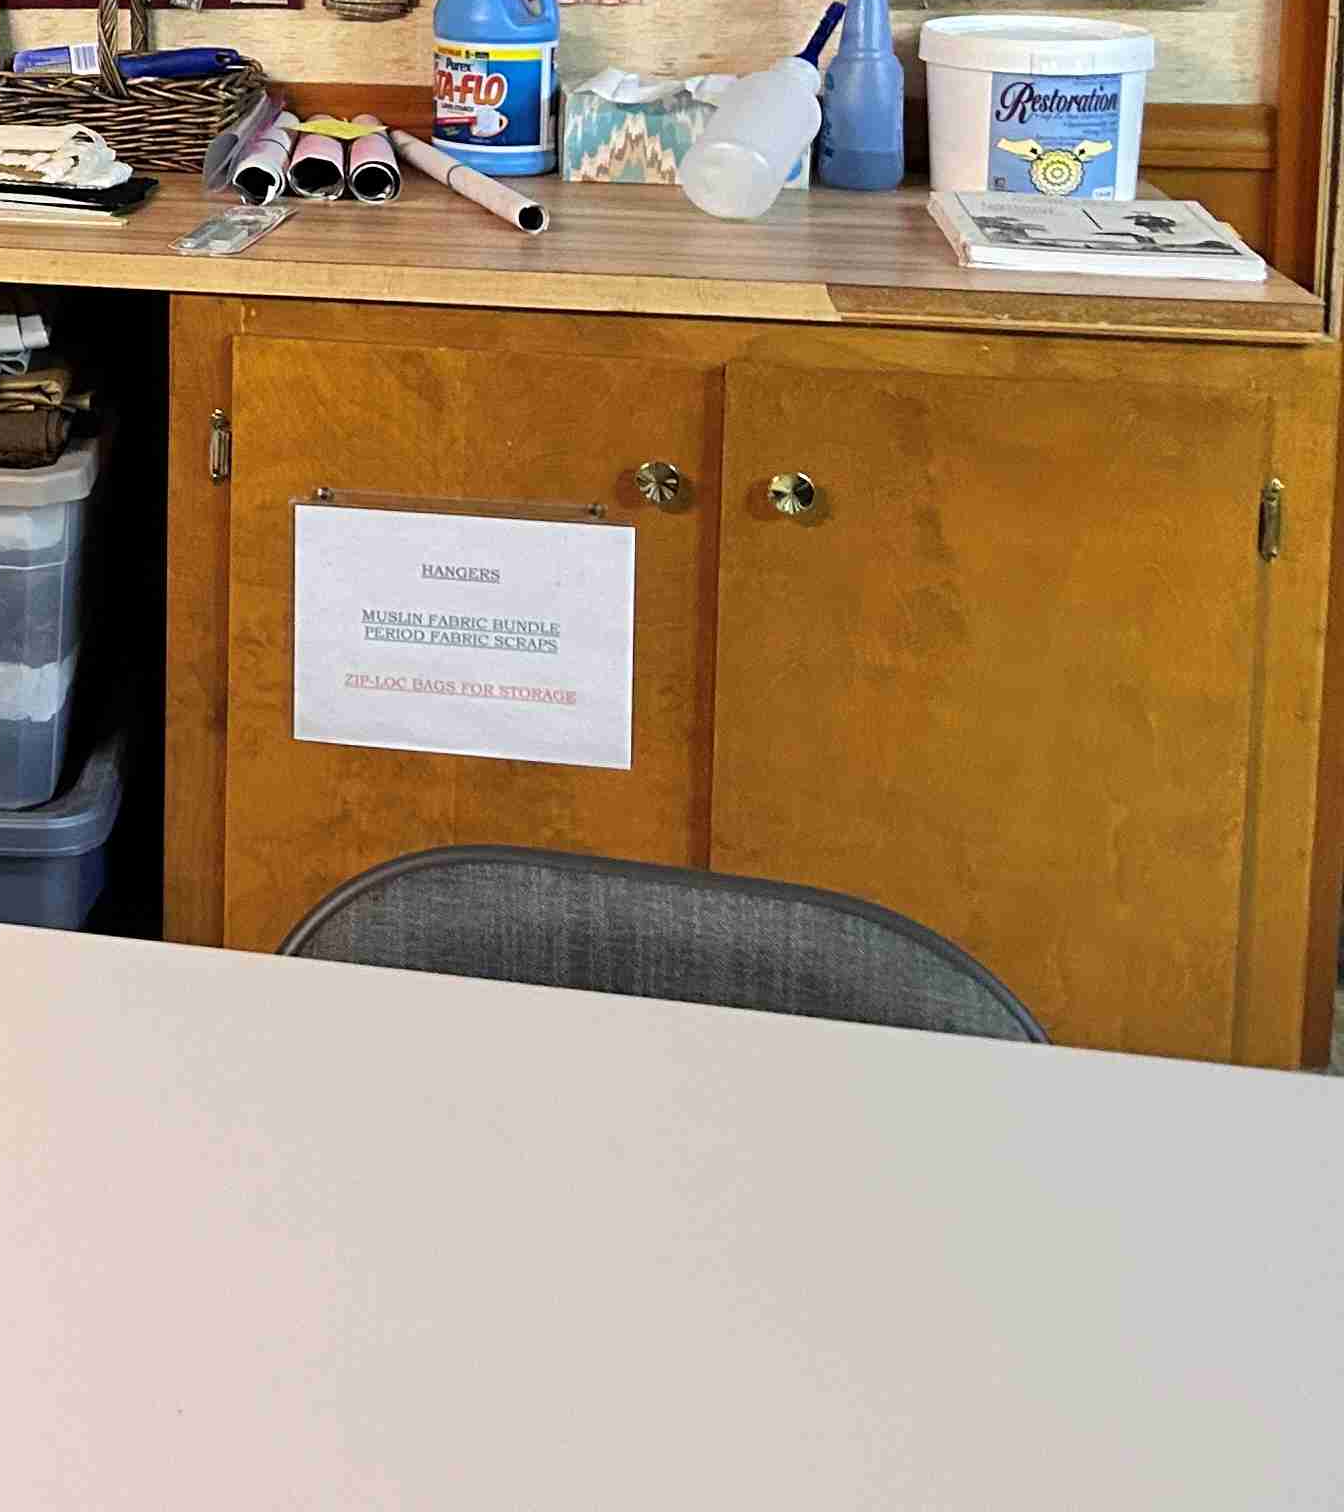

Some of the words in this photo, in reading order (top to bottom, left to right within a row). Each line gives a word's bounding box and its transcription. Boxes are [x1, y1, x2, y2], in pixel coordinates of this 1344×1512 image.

[433, 69, 507, 107] TA-FLO
[994, 81, 1119, 124] Restoration
[421, 564, 500, 583] HANGERS
[362, 609, 423, 626] MUSLIN
[428, 614, 488, 630] FABRIC
[493, 618, 560, 635] BUNDLE
[365, 626, 425, 642] PERIOD
[430, 631, 489, 647] FABRIC
[494, 635, 558, 653] SCRAPS
[345, 673, 407, 689] ZIP-LOC
[413, 678, 455, 694] BAGS
[462, 682, 495, 698] FOR
[499, 685, 577, 705] STORAGE
